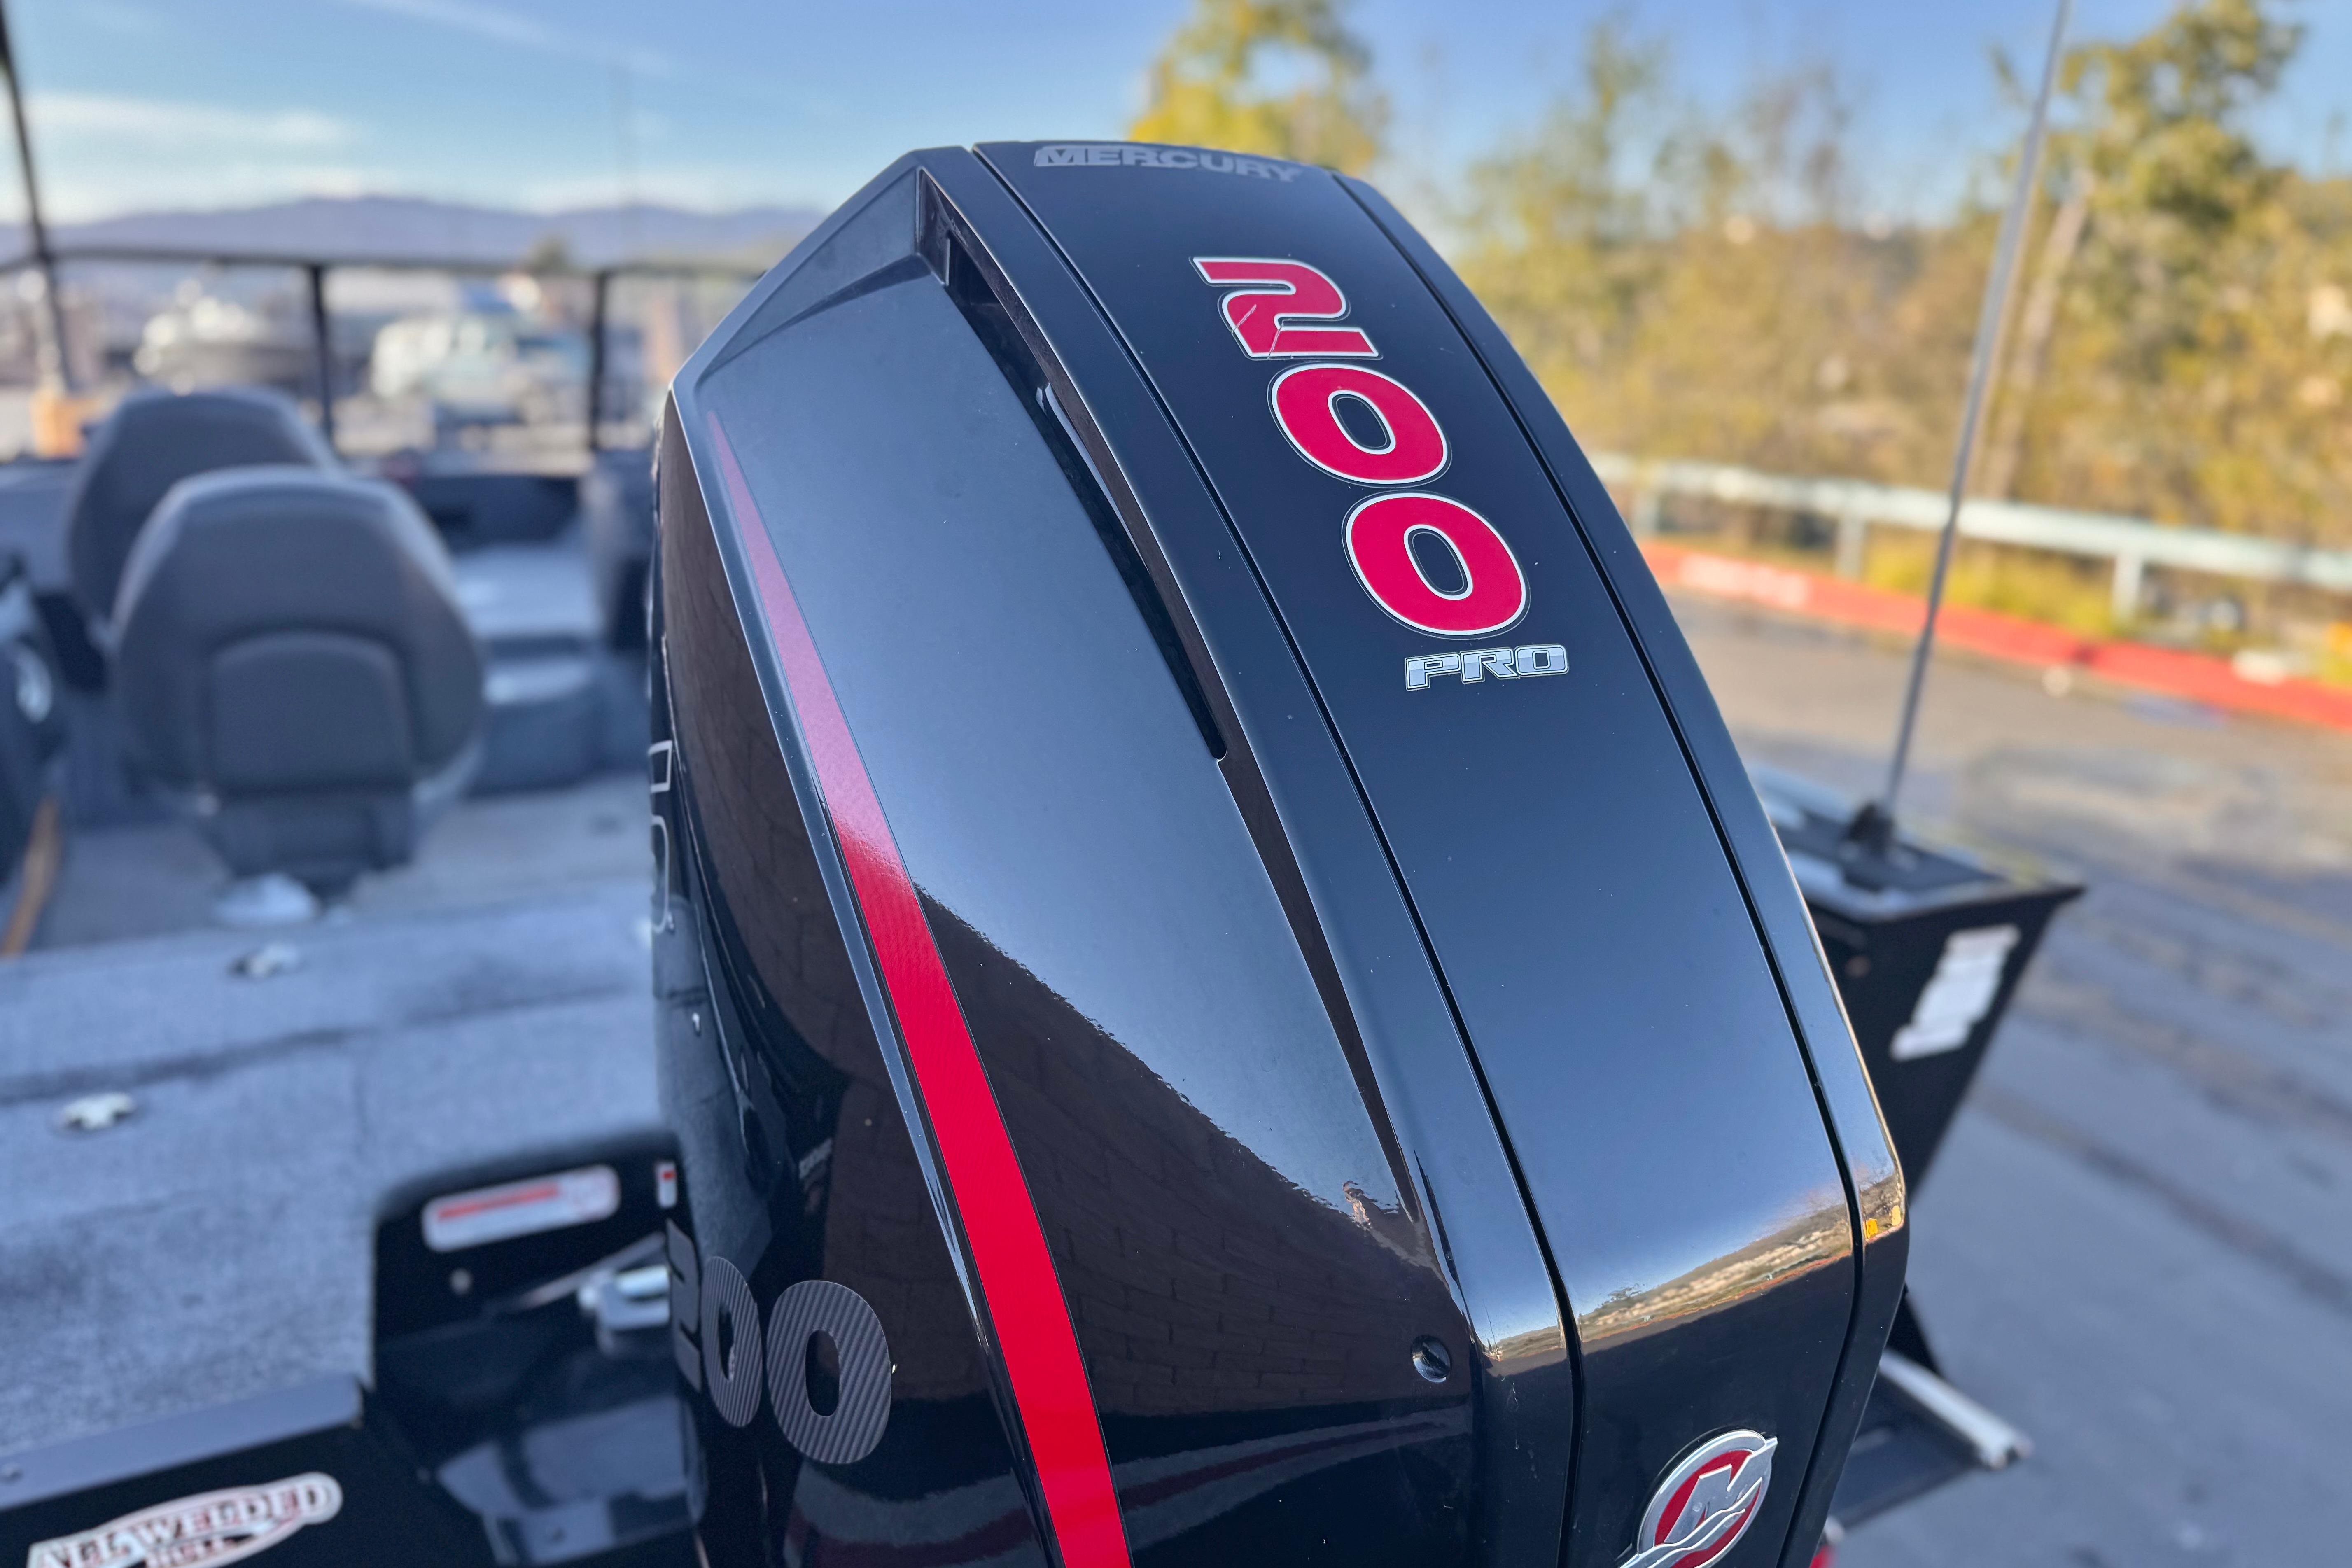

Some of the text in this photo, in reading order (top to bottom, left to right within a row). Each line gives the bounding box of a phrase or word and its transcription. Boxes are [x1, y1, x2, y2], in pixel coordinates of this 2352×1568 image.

[1034, 145, 1302, 181] MERCURY
[1191, 256, 1528, 635] 200
[1406, 645, 1569, 691] PRO
